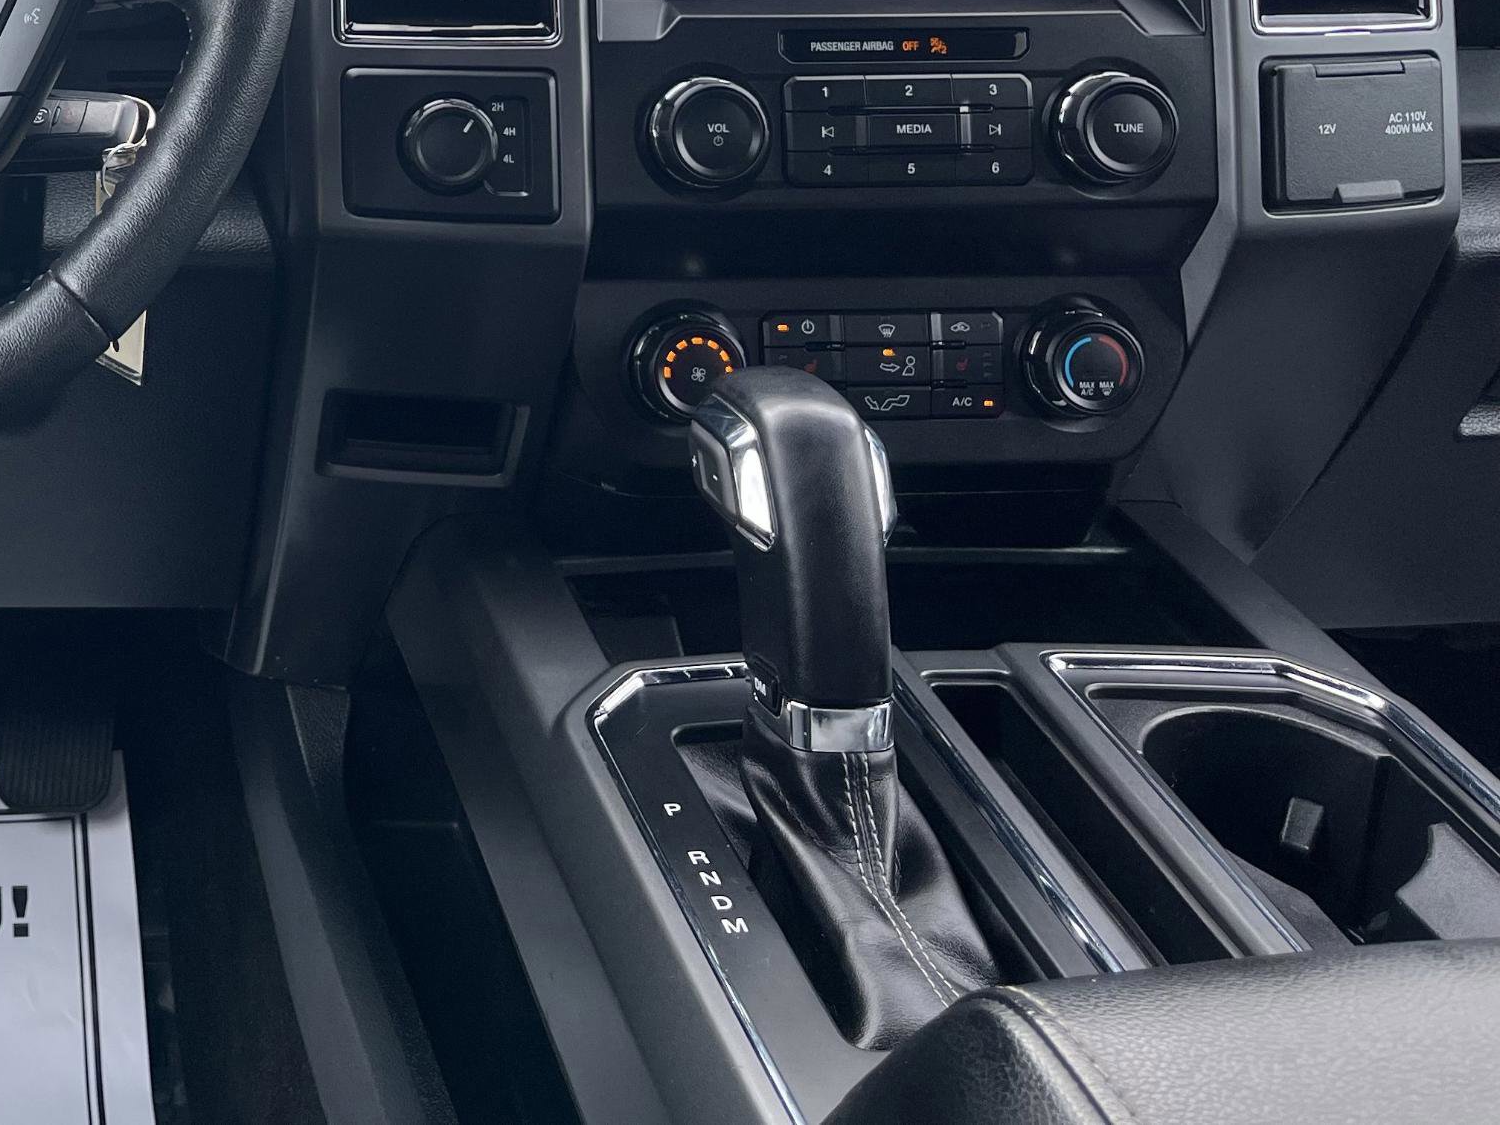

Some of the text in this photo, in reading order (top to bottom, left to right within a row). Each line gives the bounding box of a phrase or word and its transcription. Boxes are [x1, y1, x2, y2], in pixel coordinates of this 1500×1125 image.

[810, 40, 920, 52] PASSENGER AIRBAG OFF
[822, 87, 829, 97] 1
[905, 85, 913, 96] 2
[989, 84, 998, 95] 3
[492, 102, 504, 111] 2H
[1389, 111, 1426, 123] AC 110V
[503, 127, 516, 136] 4H
[707, 123, 729, 134] VOL
[897, 124, 932, 134] MEDIA
[1115, 122, 1144, 134] TUNE
[1319, 124, 1336, 134] 12V
[1385, 122, 1434, 135] 400W MAX
[503, 154, 515, 164] 4L
[823, 165, 832, 175] 4
[907, 163, 916, 174] 5
[991, 162, 1000, 173] 6
[952, 397, 973, 408] A/C
[664, 803, 682, 817] P
[687, 850, 710, 865] R
[699, 871, 722, 886] N
[711, 895, 733, 911] D
[721, 917, 749, 933] M
